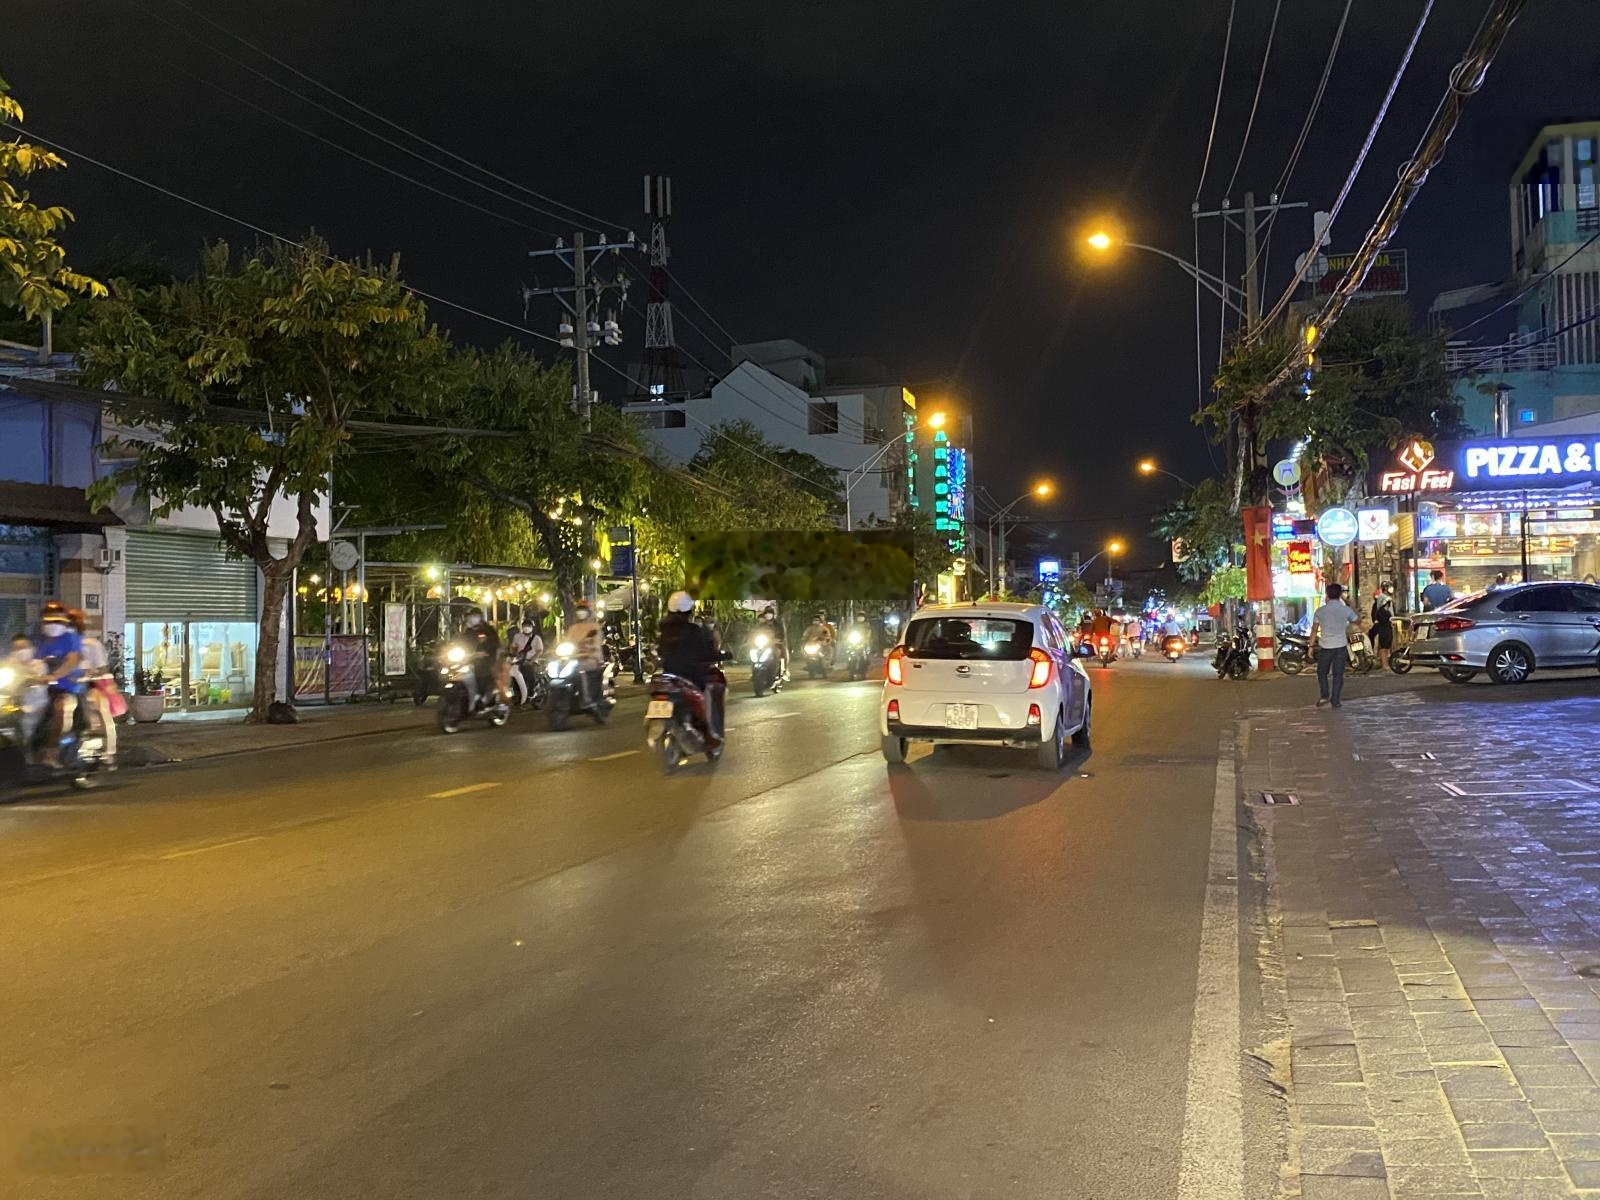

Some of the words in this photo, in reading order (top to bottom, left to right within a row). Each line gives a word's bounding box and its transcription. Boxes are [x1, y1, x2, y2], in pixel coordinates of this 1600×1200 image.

[1466, 445, 1562, 477] PIZZA
[1564, 443, 1591, 472] &
[1421, 470, 1454, 489] Feel
